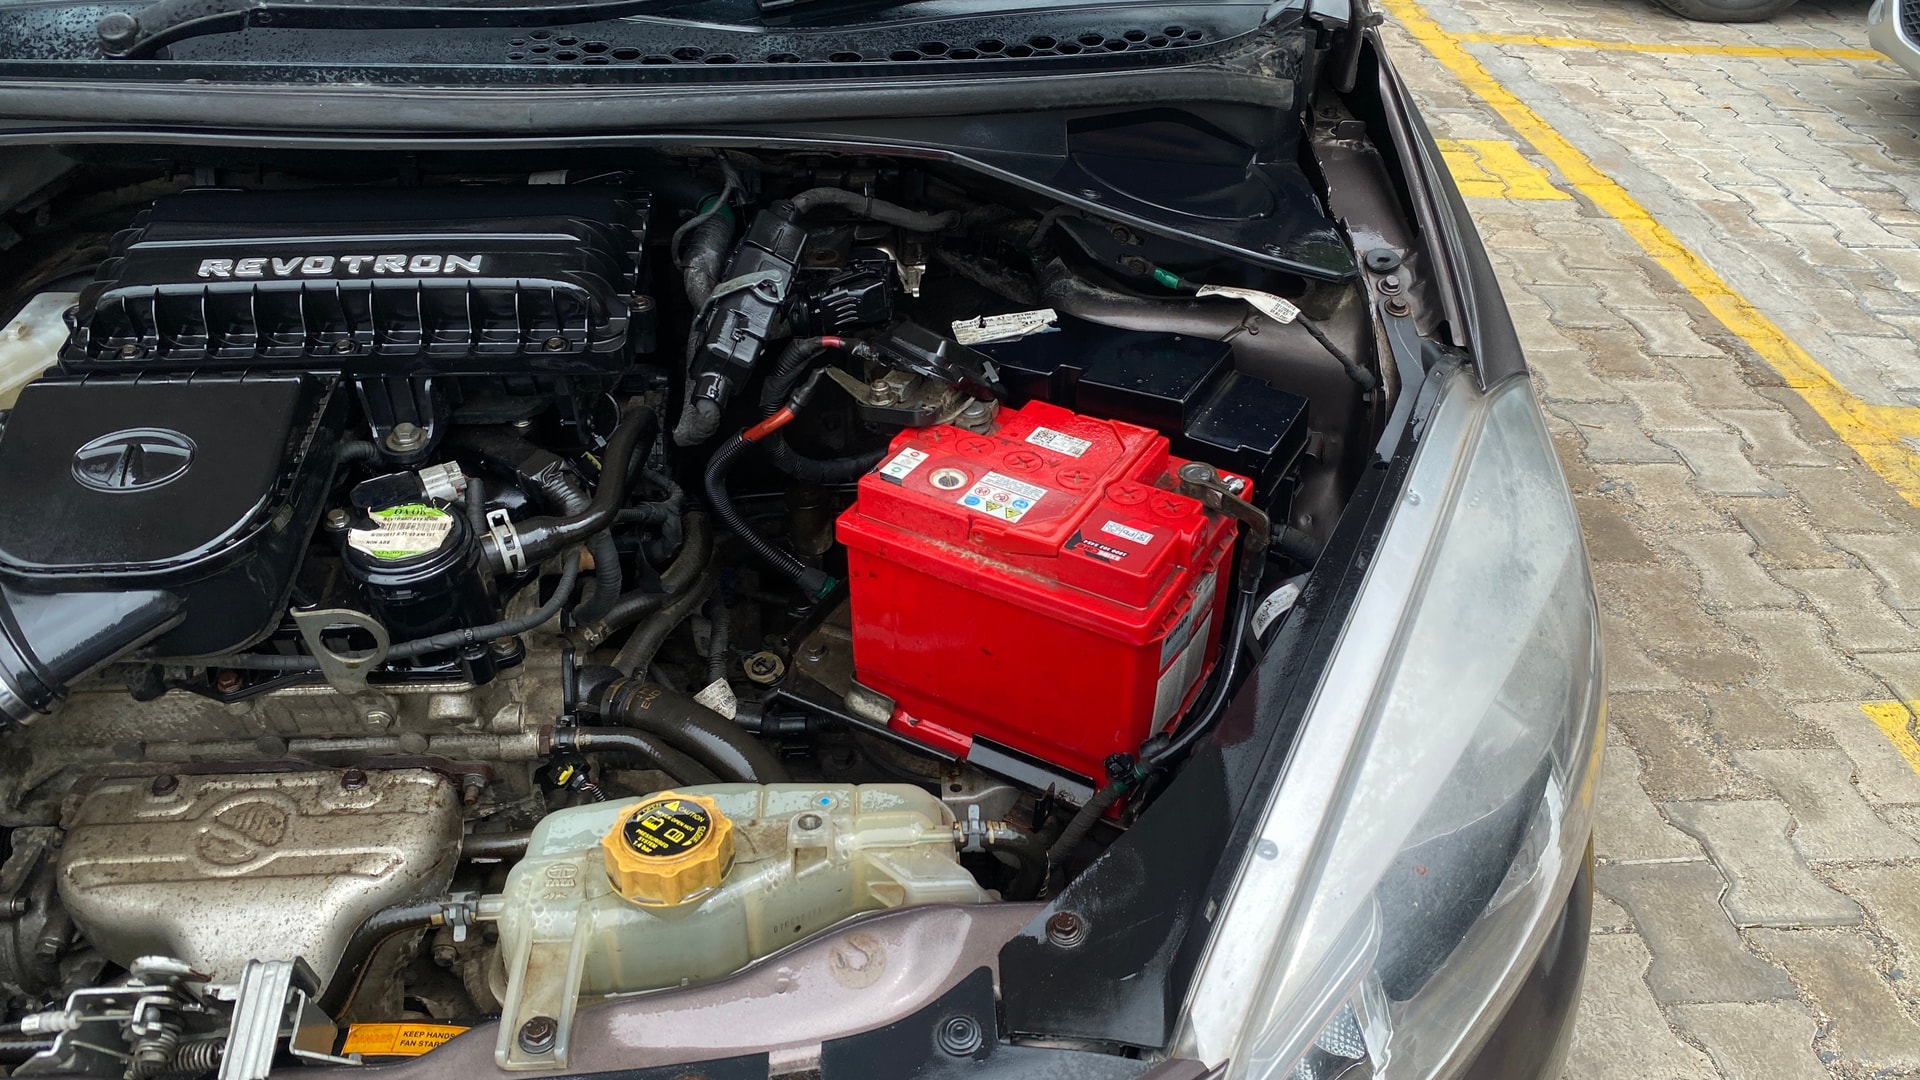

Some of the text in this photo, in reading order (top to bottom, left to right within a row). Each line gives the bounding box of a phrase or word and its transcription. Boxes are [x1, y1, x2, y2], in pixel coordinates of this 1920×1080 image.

[197, 254, 483, 278] REVOTRON
[678, 806, 705, 823] CAUTION
[670, 817, 685, 827] OPEN
[637, 836, 658, 849] SYSTEM
[641, 844, 653, 853] bar
[403, 1030, 425, 1038] KEEP
